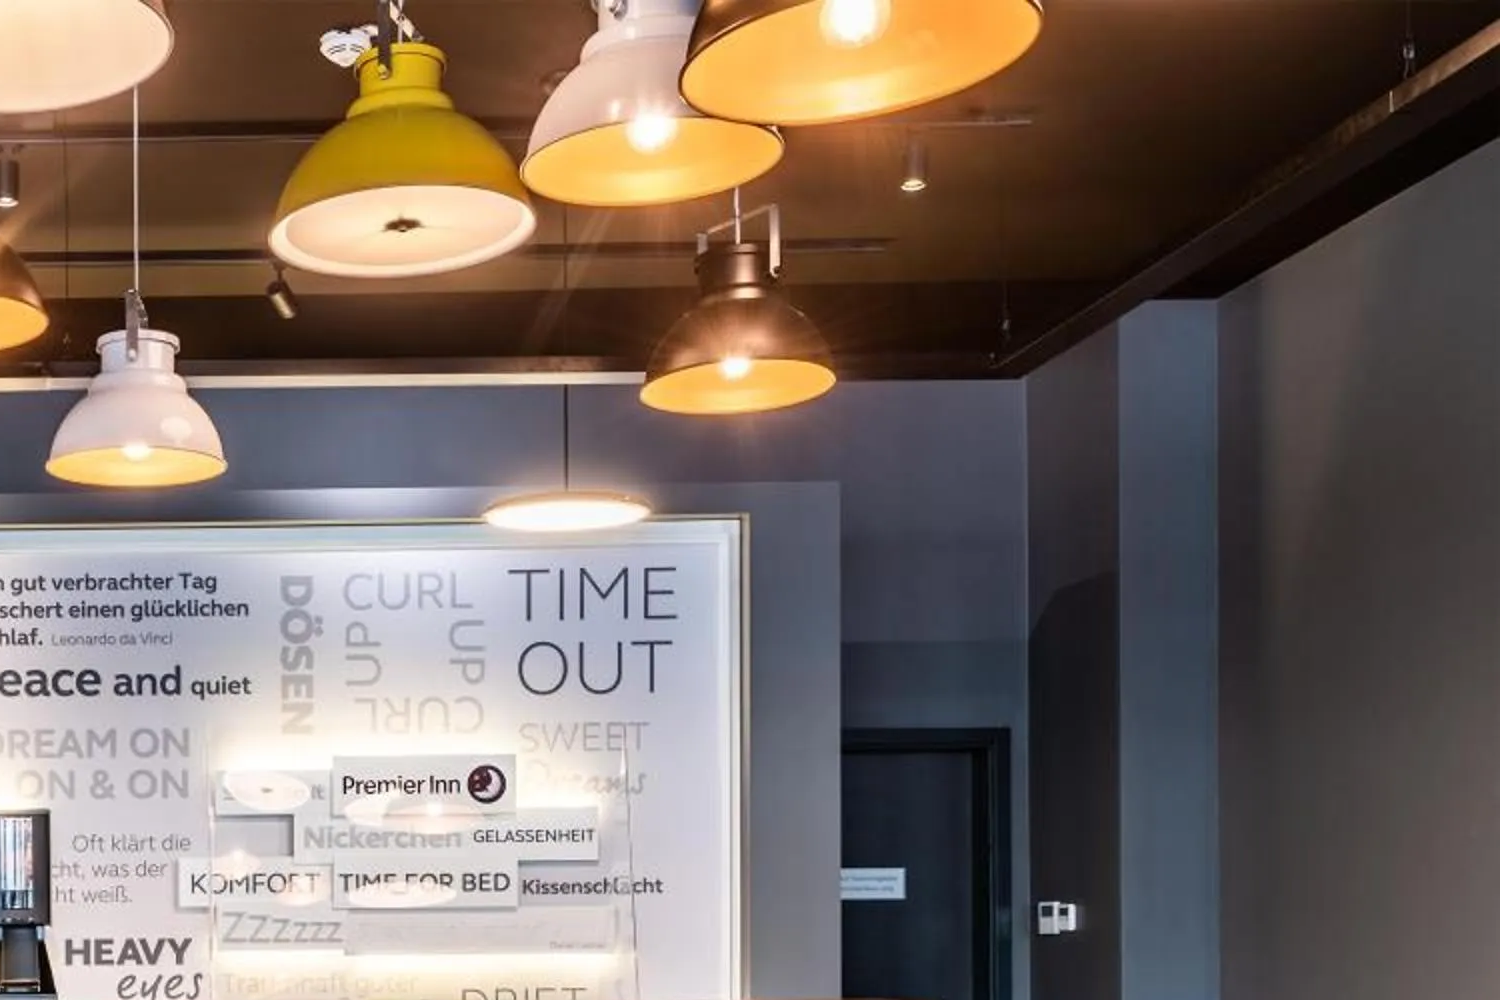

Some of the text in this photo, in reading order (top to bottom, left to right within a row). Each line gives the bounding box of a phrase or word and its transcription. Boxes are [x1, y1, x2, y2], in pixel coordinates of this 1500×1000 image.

[10, 576, 46, 595] gut
[51, 573, 173, 591] verbrachter
[178, 572, 217, 593] Tag
[343, 572, 474, 611] CURL
[508, 567, 678, 621] TIME
[68, 601, 125, 618] einen
[131, 599, 249, 621] glücklichen
[51, 632, 116, 646] Leonardo
[119, 632, 136, 646] da
[140, 631, 174, 646] Vinci
[449, 619, 487, 685] UP
[280, 576, 324, 734] DÖSEN
[345, 621, 382, 687] UP
[518, 641, 673, 695] OUT
[113, 665, 181, 696] and
[190, 675, 252, 700] quiet
[354, 696, 485, 734] CURL
[129, 727, 190, 758] ON
[519, 722, 650, 752] SWEET
[16, 769, 76, 799] ON
[89, 769, 116, 799] &
[128, 769, 190, 799] ON
[343, 774, 425, 795] Premier
[429, 775, 460, 794] Inn
[72, 834, 191, 852] Oft klärt die
[473, 829, 596, 843] GELASSENHEIT
[51, 860, 168, 880] cht, was der
[462, 872, 512, 893] BED
[82, 885, 133, 904] weiß.
[64, 938, 193, 966] HEAVY
